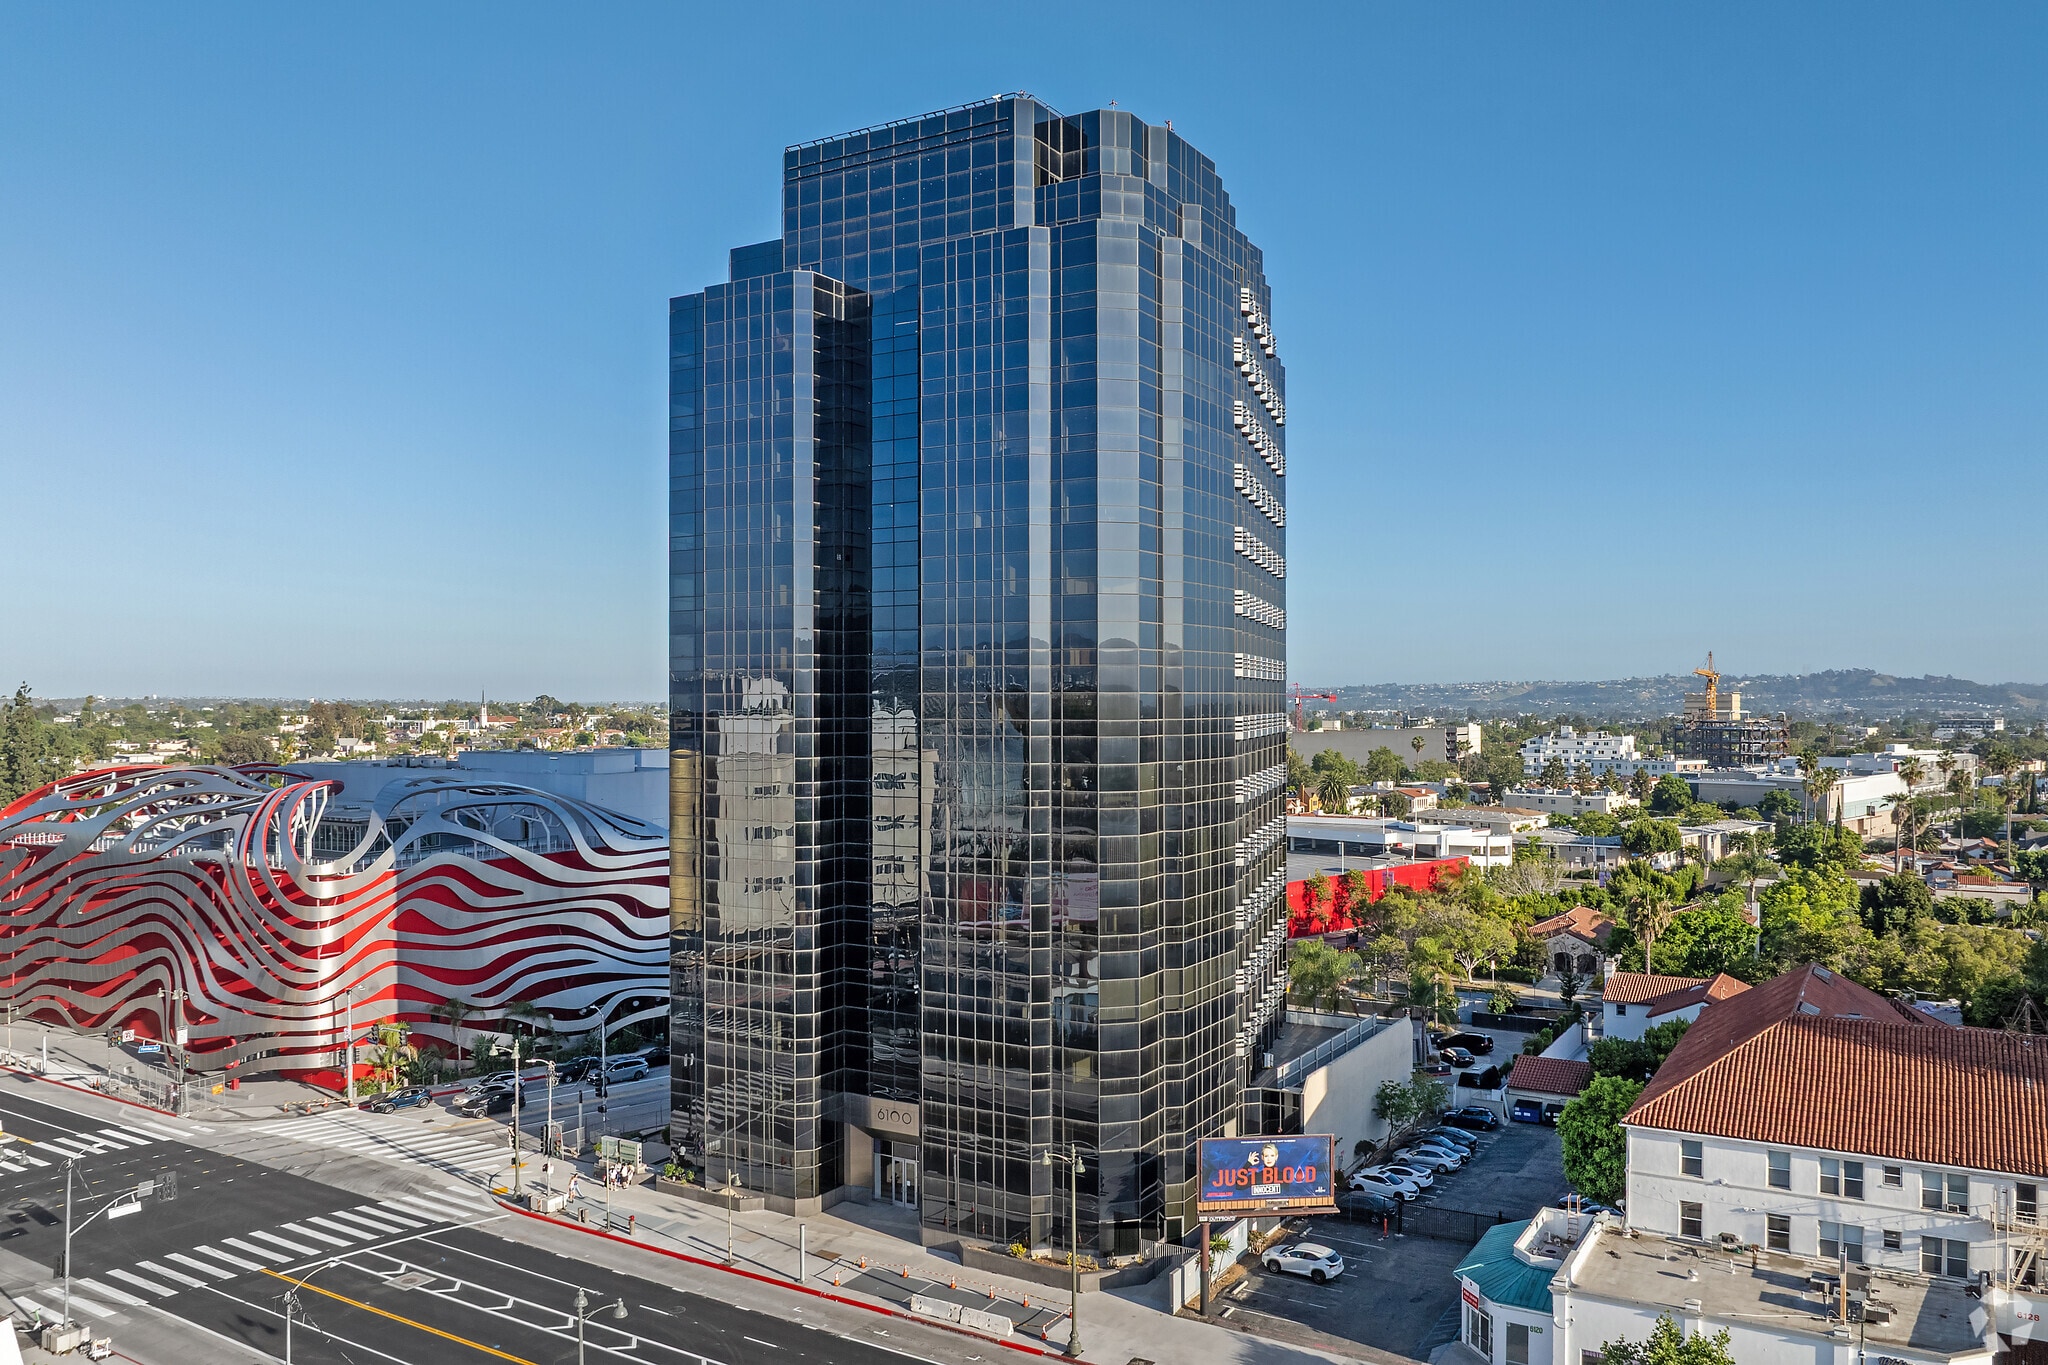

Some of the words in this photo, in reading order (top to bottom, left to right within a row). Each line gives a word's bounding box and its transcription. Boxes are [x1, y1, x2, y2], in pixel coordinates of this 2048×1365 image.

[877, 1108, 912, 1125] 6100
[1212, 1167, 1259, 1187] JUST
[1263, 1165, 1317, 1184] BLOOD
[2017, 1312, 2041, 1322] 6128
[1530, 1325, 1543, 1334] 6120
